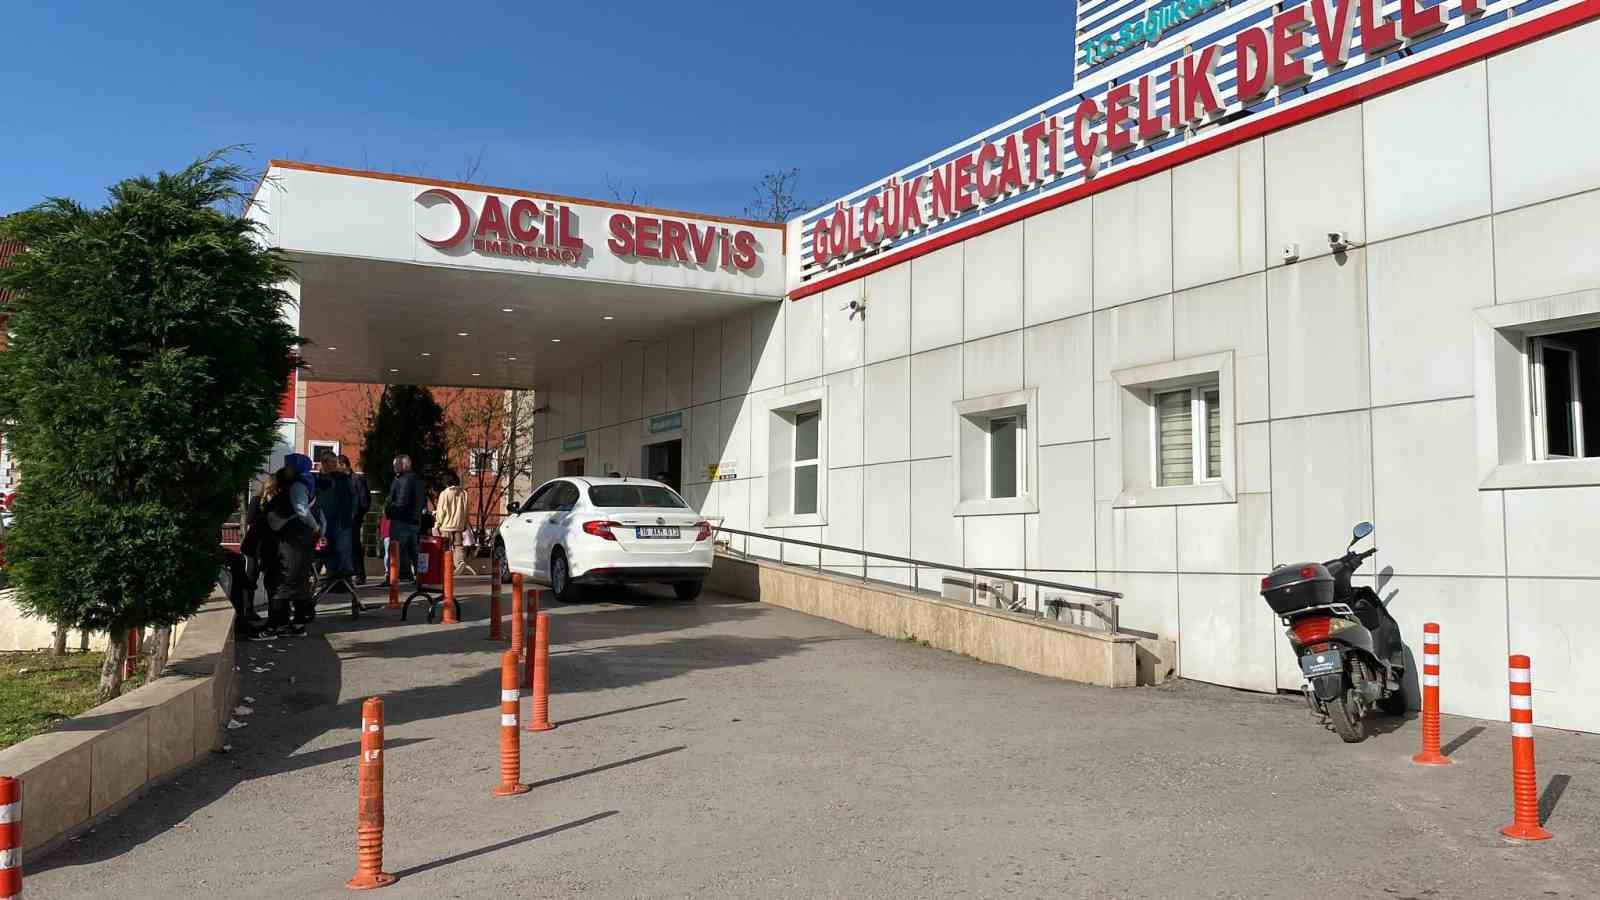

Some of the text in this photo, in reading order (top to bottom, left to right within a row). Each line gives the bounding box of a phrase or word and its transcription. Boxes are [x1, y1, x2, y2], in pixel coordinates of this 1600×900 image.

[812, 0, 1480, 265] GÖLCÜK NECATİ ÇELİK DEVL
[473, 238, 580, 265] EMERGENCY
[474, 195, 758, 271] ACİL SERVİS
